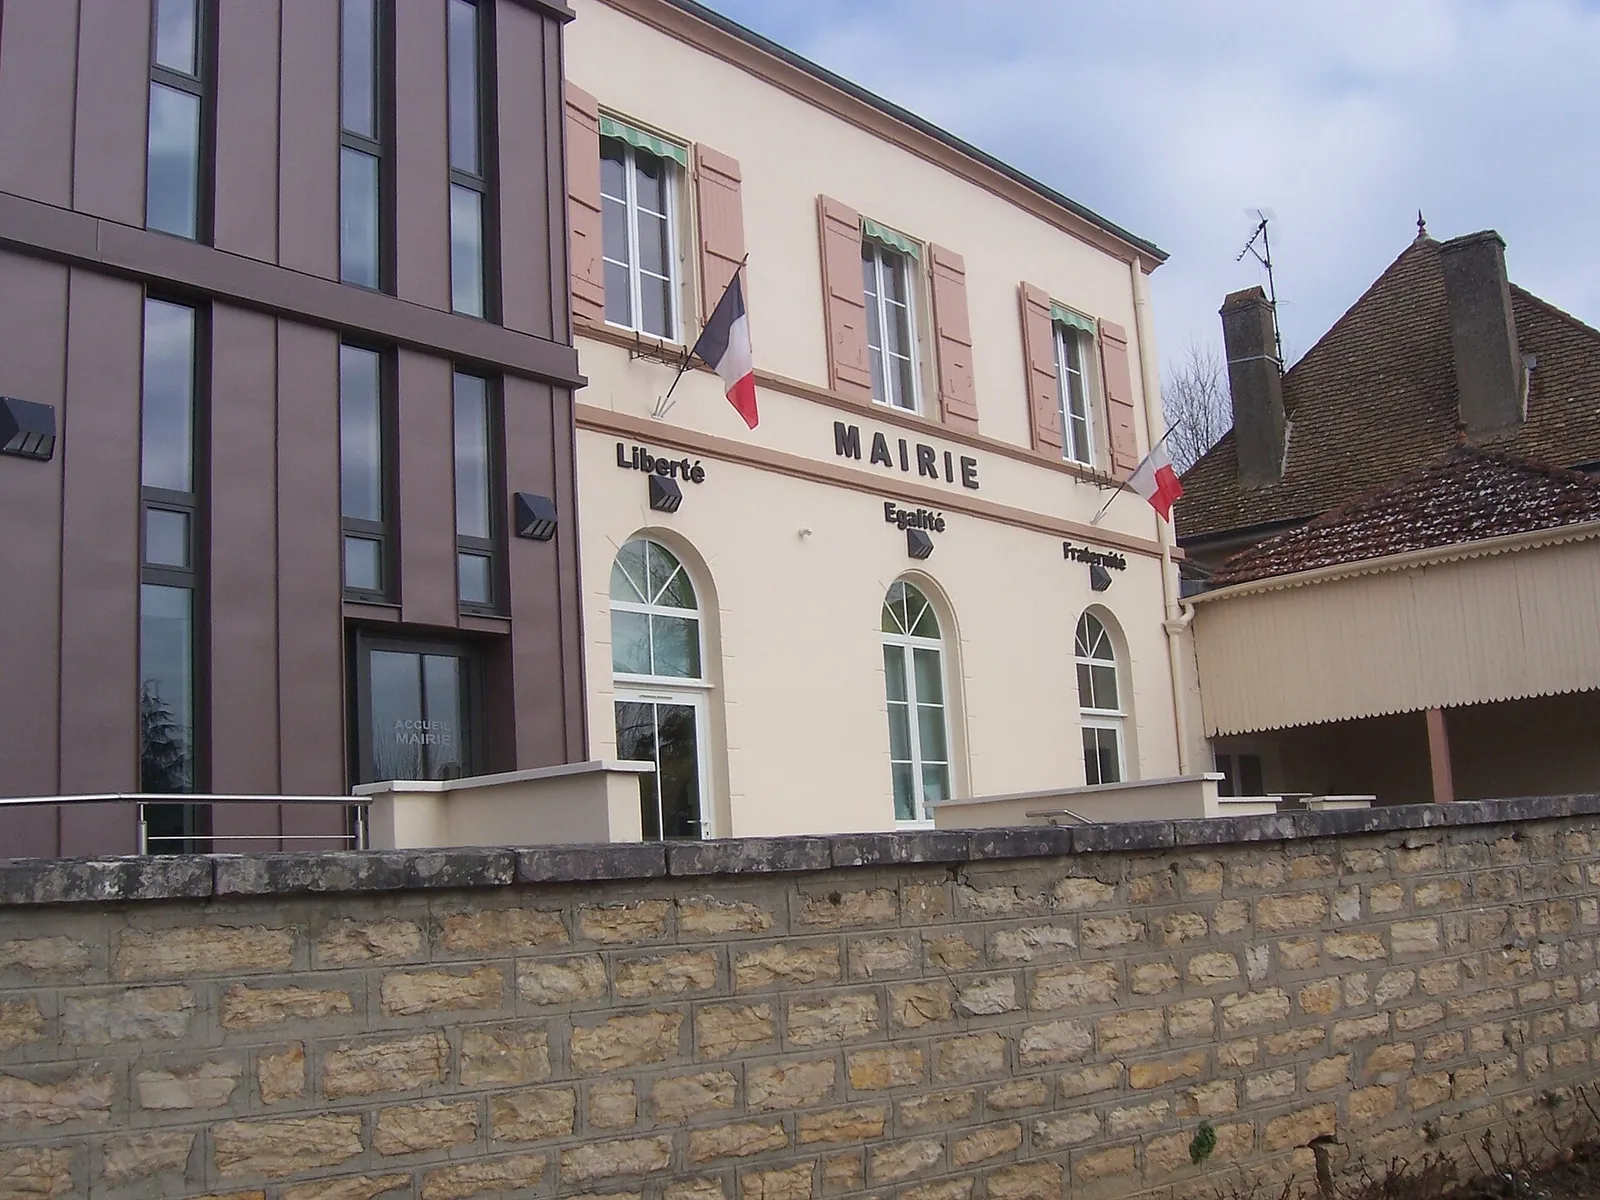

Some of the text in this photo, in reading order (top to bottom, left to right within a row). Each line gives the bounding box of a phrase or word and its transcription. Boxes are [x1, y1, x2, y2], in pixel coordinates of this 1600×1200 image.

[616, 442, 705, 484] Liberté
[834, 421, 980, 489] MAIRIE
[884, 502, 945, 533] Egalité
[394, 719, 451, 731] ACCUEIL
[395, 733, 451, 745] MAIRIE
